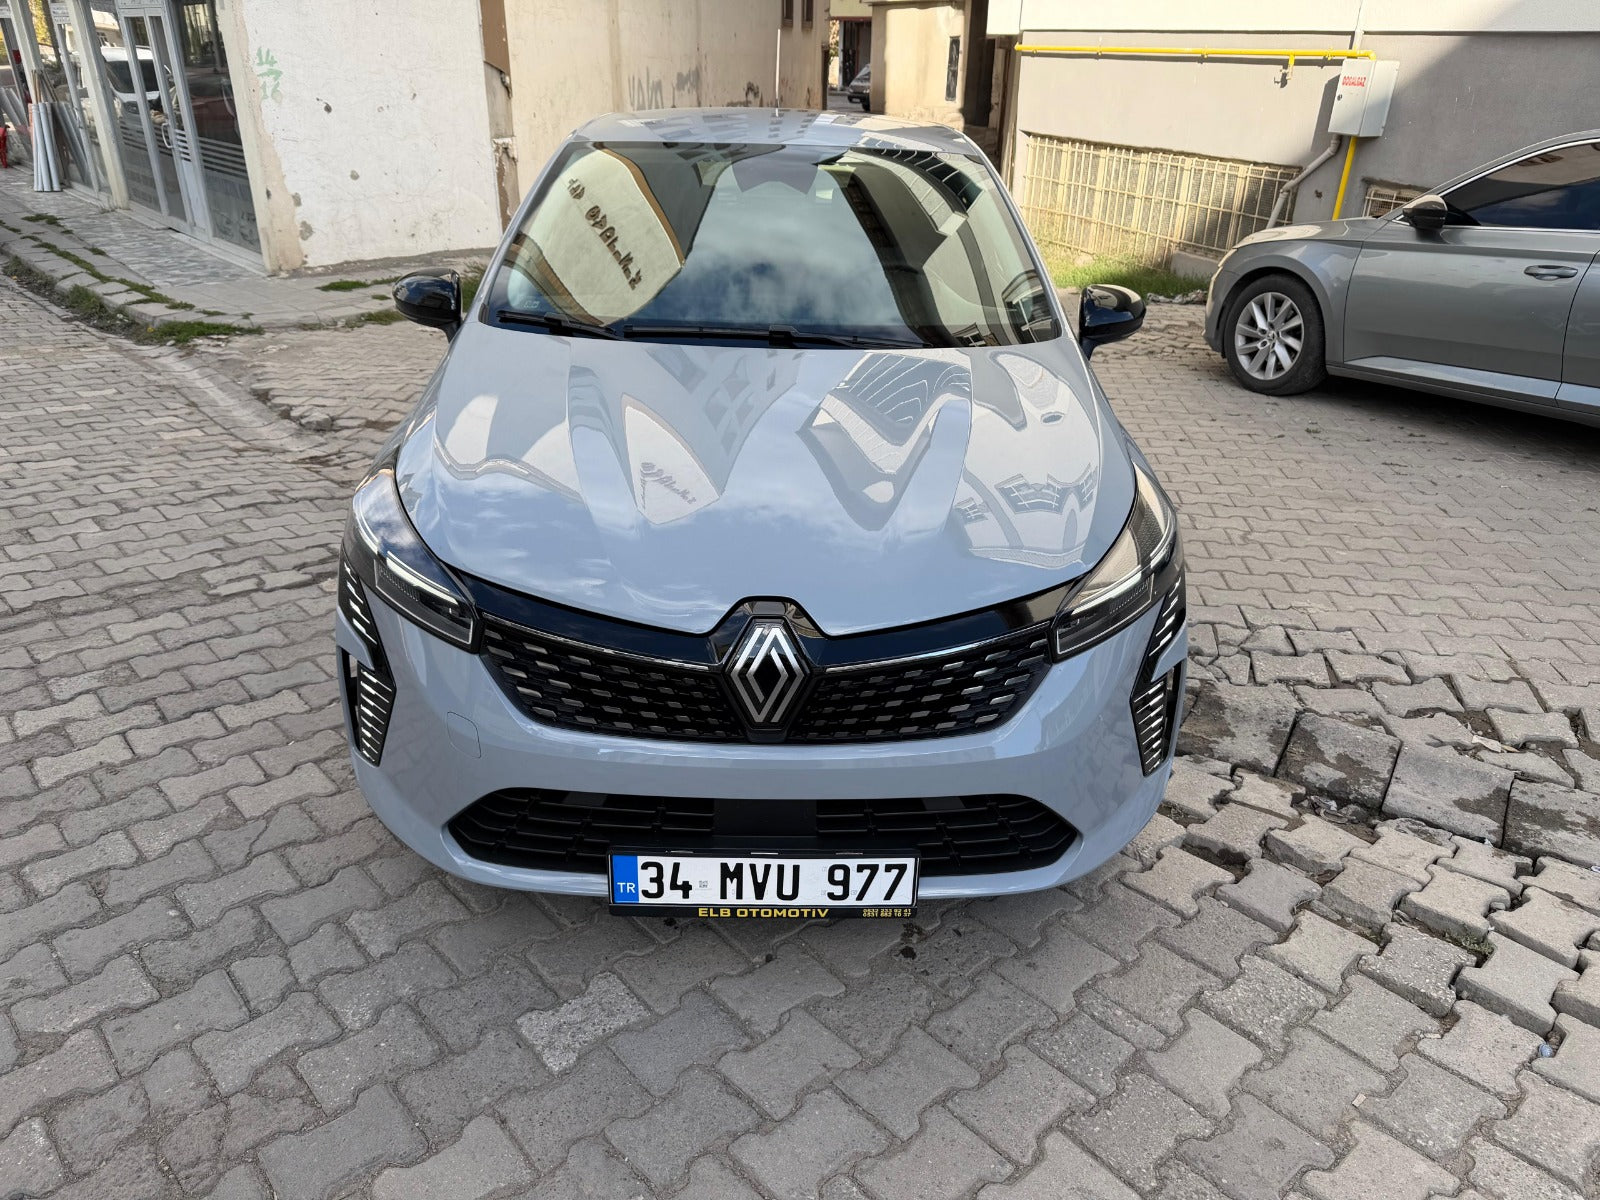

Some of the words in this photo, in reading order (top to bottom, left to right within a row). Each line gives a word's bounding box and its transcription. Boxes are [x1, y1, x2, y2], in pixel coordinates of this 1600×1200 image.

[640, 861, 693, 900] 34
[720, 862, 801, 901] MVU
[827, 863, 908, 901] 977
[617, 882, 636, 893] TR
[698, 907, 731, 918] ELB
